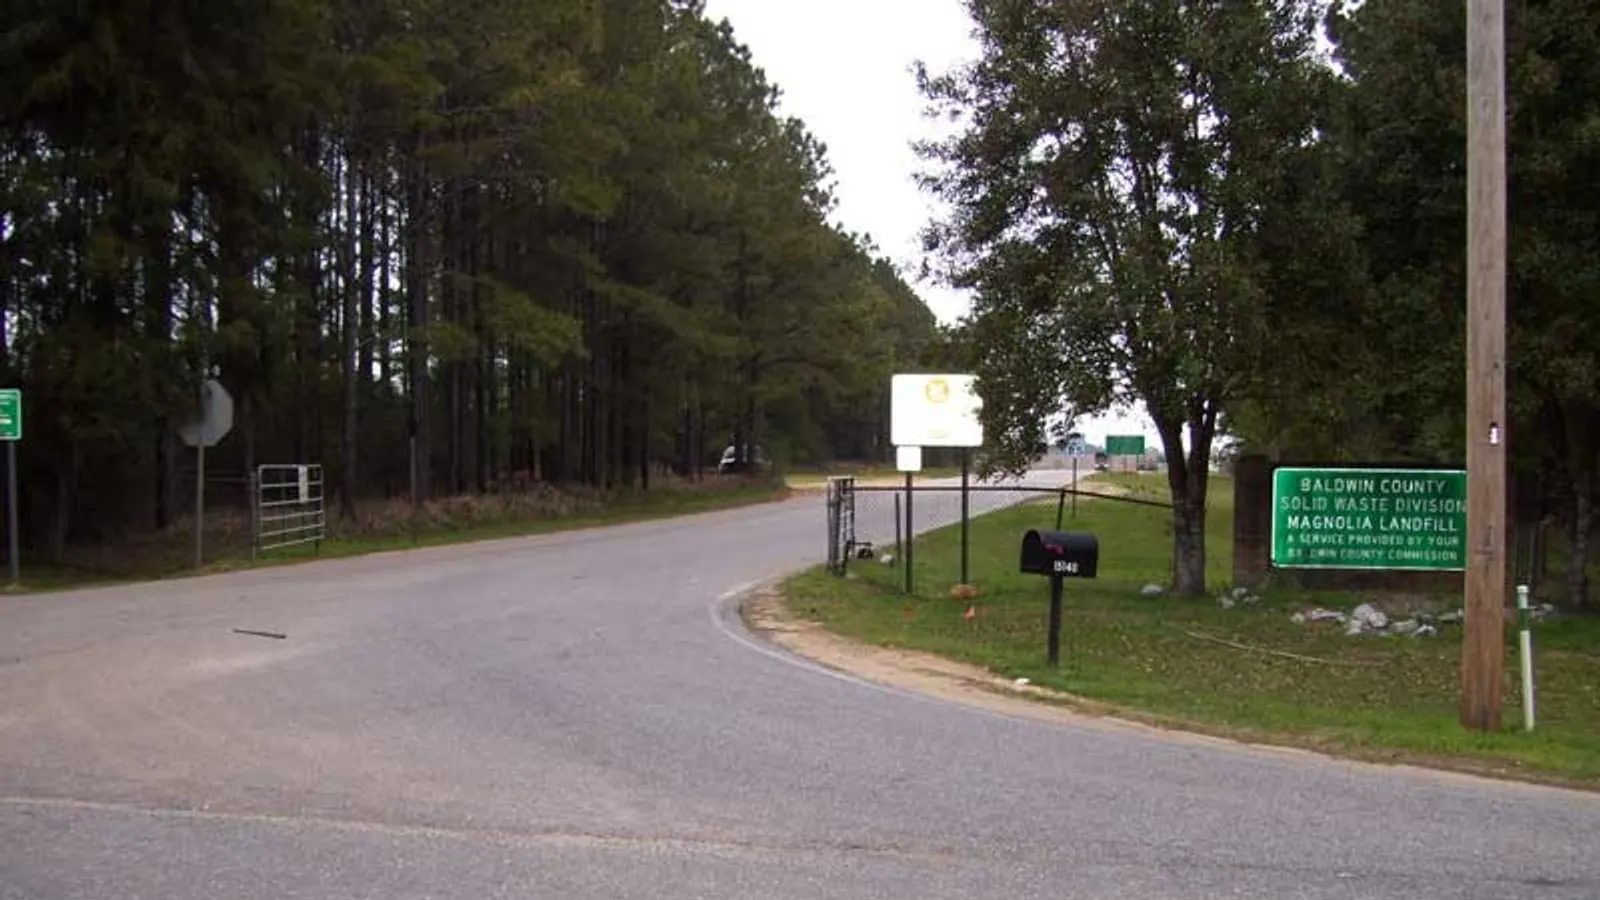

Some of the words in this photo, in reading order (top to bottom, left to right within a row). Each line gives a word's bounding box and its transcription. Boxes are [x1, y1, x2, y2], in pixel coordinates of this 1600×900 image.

[1300, 478, 1374, 493] BALDWIN
[1380, 479, 1447, 494] COUNTY
[1280, 496, 1328, 511] SOLID
[1334, 497, 1388, 512] WASTE
[1396, 498, 1467, 513] DIVISION
[1287, 516, 1373, 530] MAGNOLIA
[1379, 517, 1458, 531] LANDFILL
[1287, 535, 1294, 543] A
[1300, 534, 1344, 545] SERVICE
[1348, 535, 1403, 545] PROVIDED
[1408, 535, 1422, 545] BY
[1428, 536, 1460, 546] YOUR
[1287, 548, 1337, 559] BADWIN
[1340, 549, 1384, 560] COUNTY
[1388, 549, 1458, 561] COMMISSION
